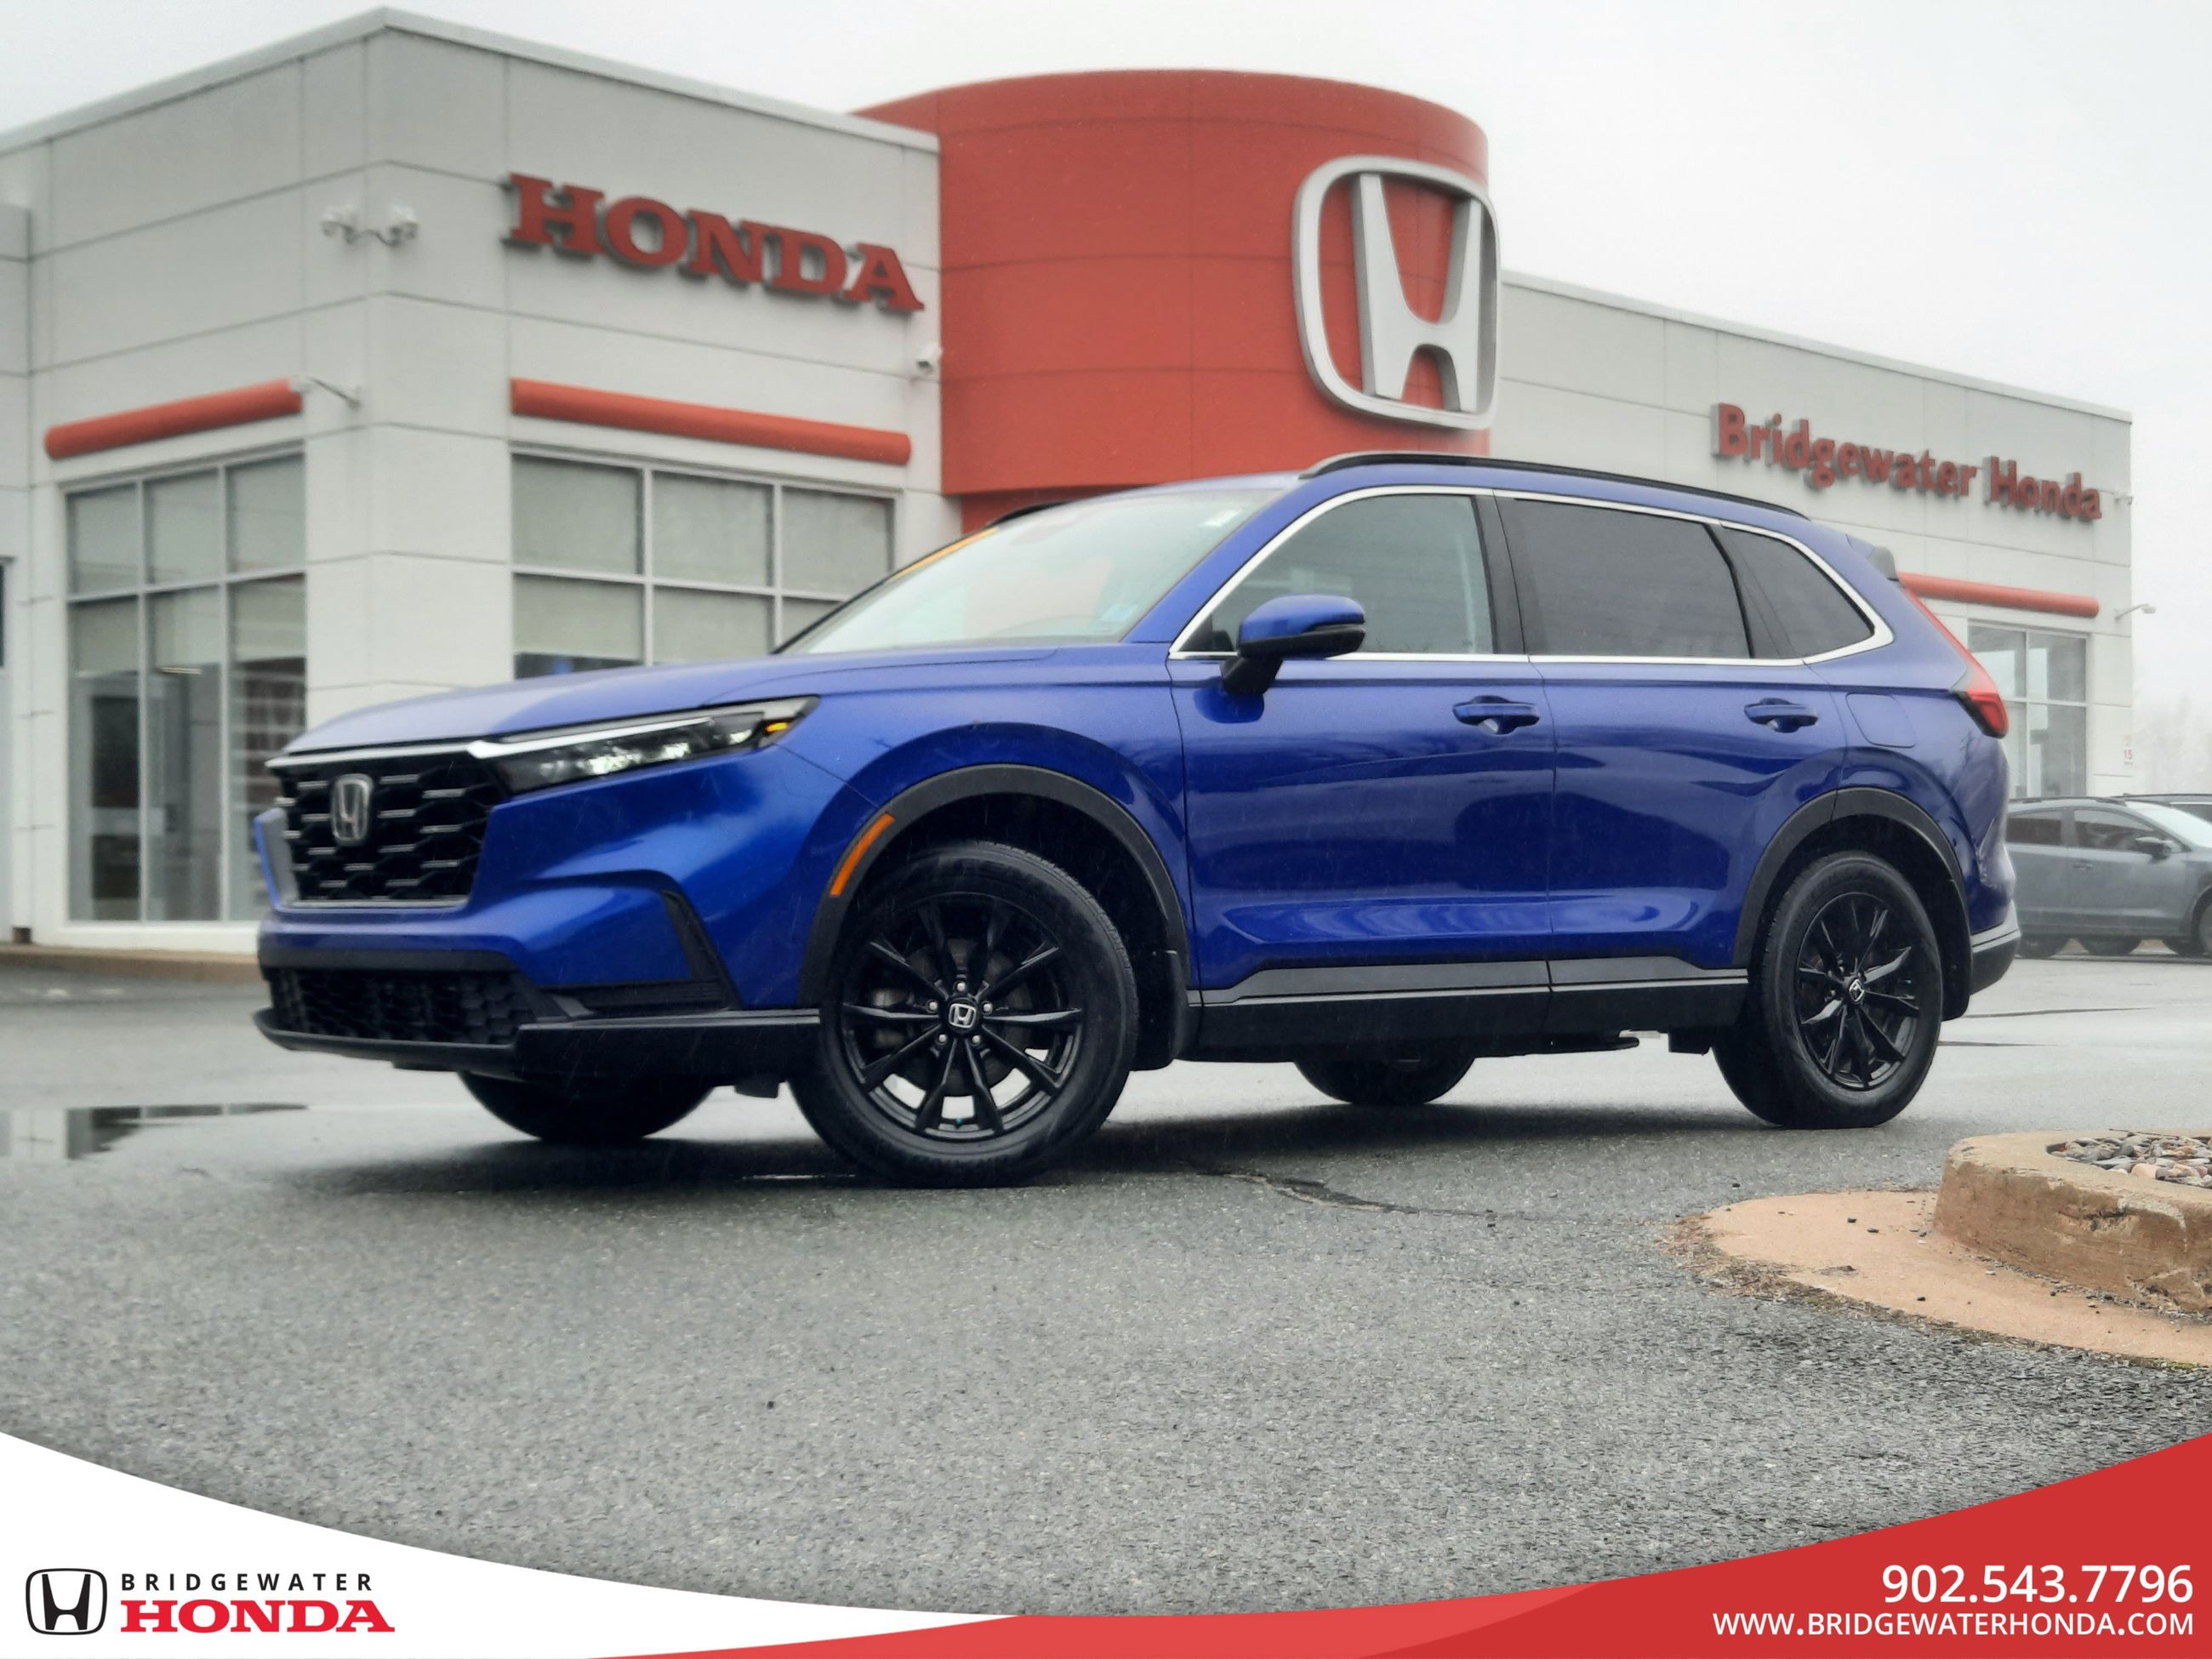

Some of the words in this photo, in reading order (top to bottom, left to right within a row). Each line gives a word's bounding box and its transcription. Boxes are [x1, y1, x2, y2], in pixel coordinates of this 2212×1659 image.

[508, 173, 924, 311] HONDA
[1715, 402, 1977, 496] Bridgewater
[1985, 455, 2102, 520] Honda
